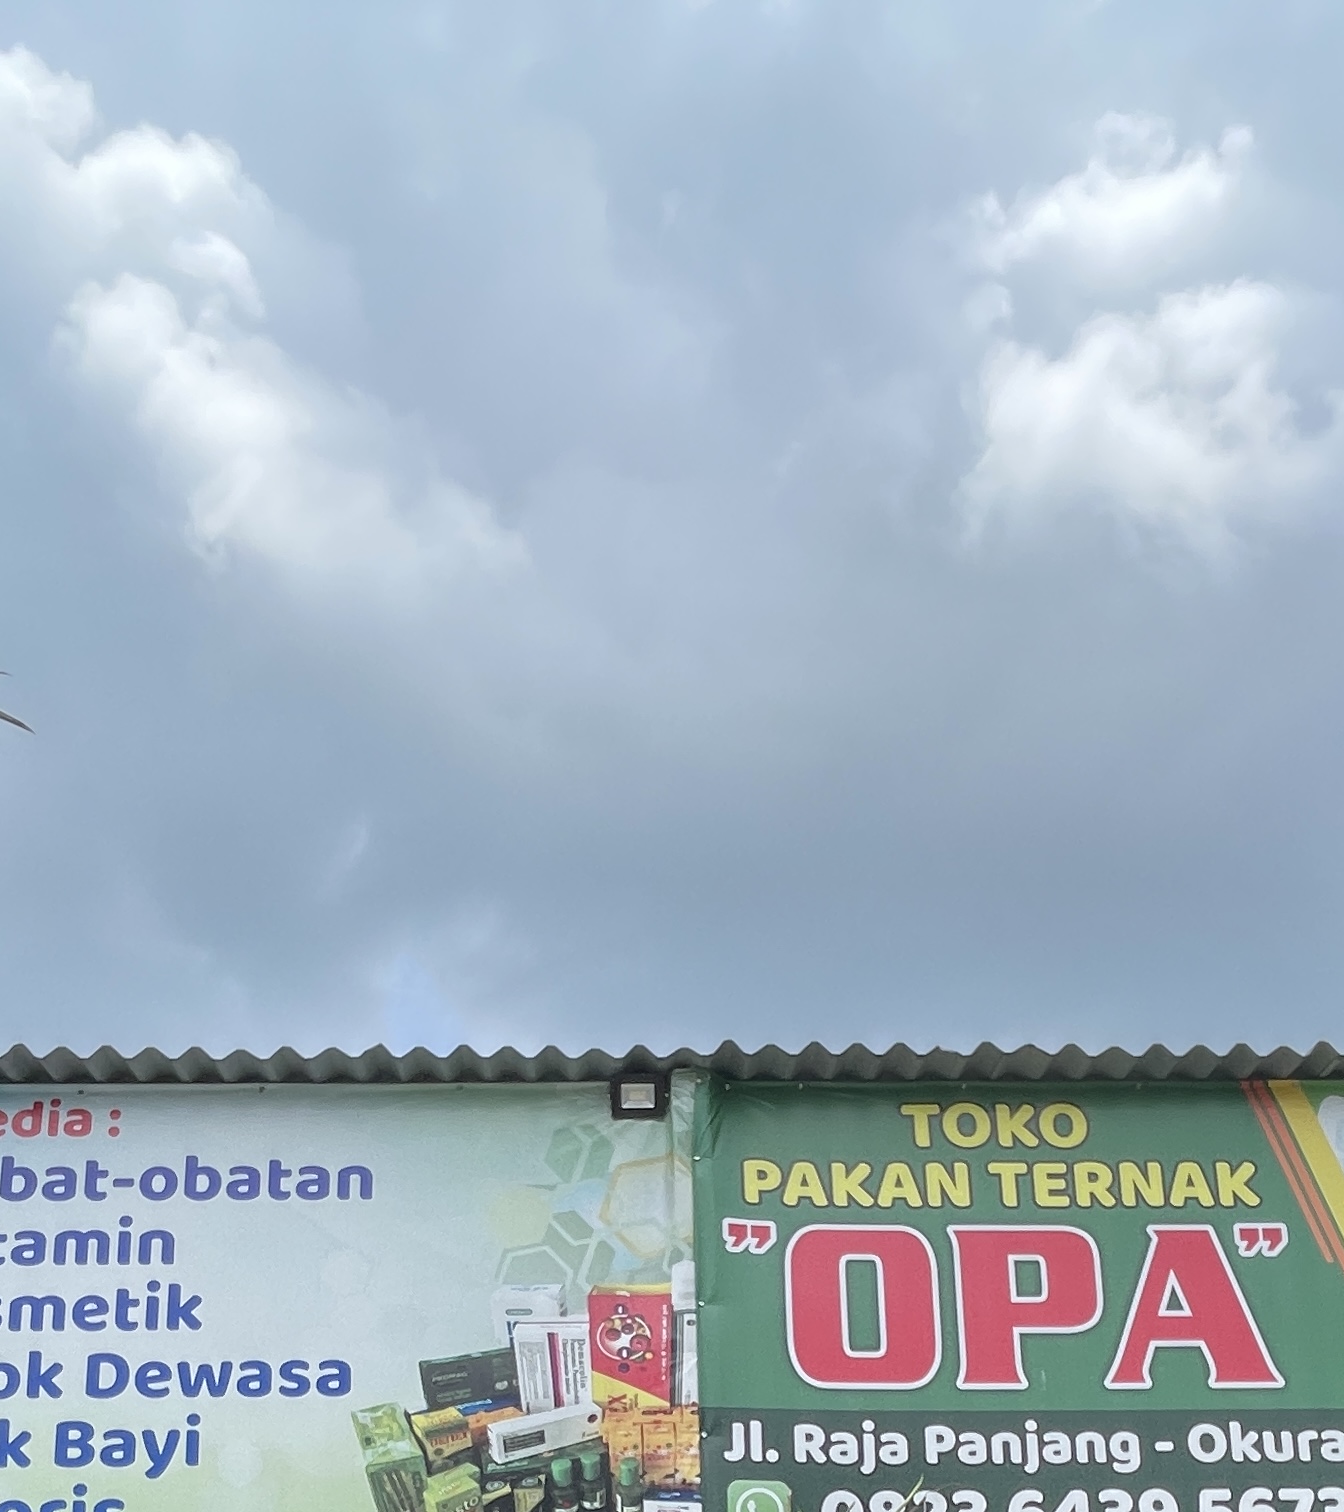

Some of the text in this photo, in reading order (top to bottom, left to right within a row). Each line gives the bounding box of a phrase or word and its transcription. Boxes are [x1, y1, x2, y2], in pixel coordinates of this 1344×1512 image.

[901, 1102, 1088, 1149] TOKO
[742, 1159, 1261, 1209] PAKAN TERNAK
[84, 1353, 354, 1399] Dewasa
[55, 1414, 202, 1481] Bayi
[723, 1422, 779, 1464] Jl.
[793, 1420, 909, 1475] Raja
[925, 1419, 1141, 1475] Panjang
